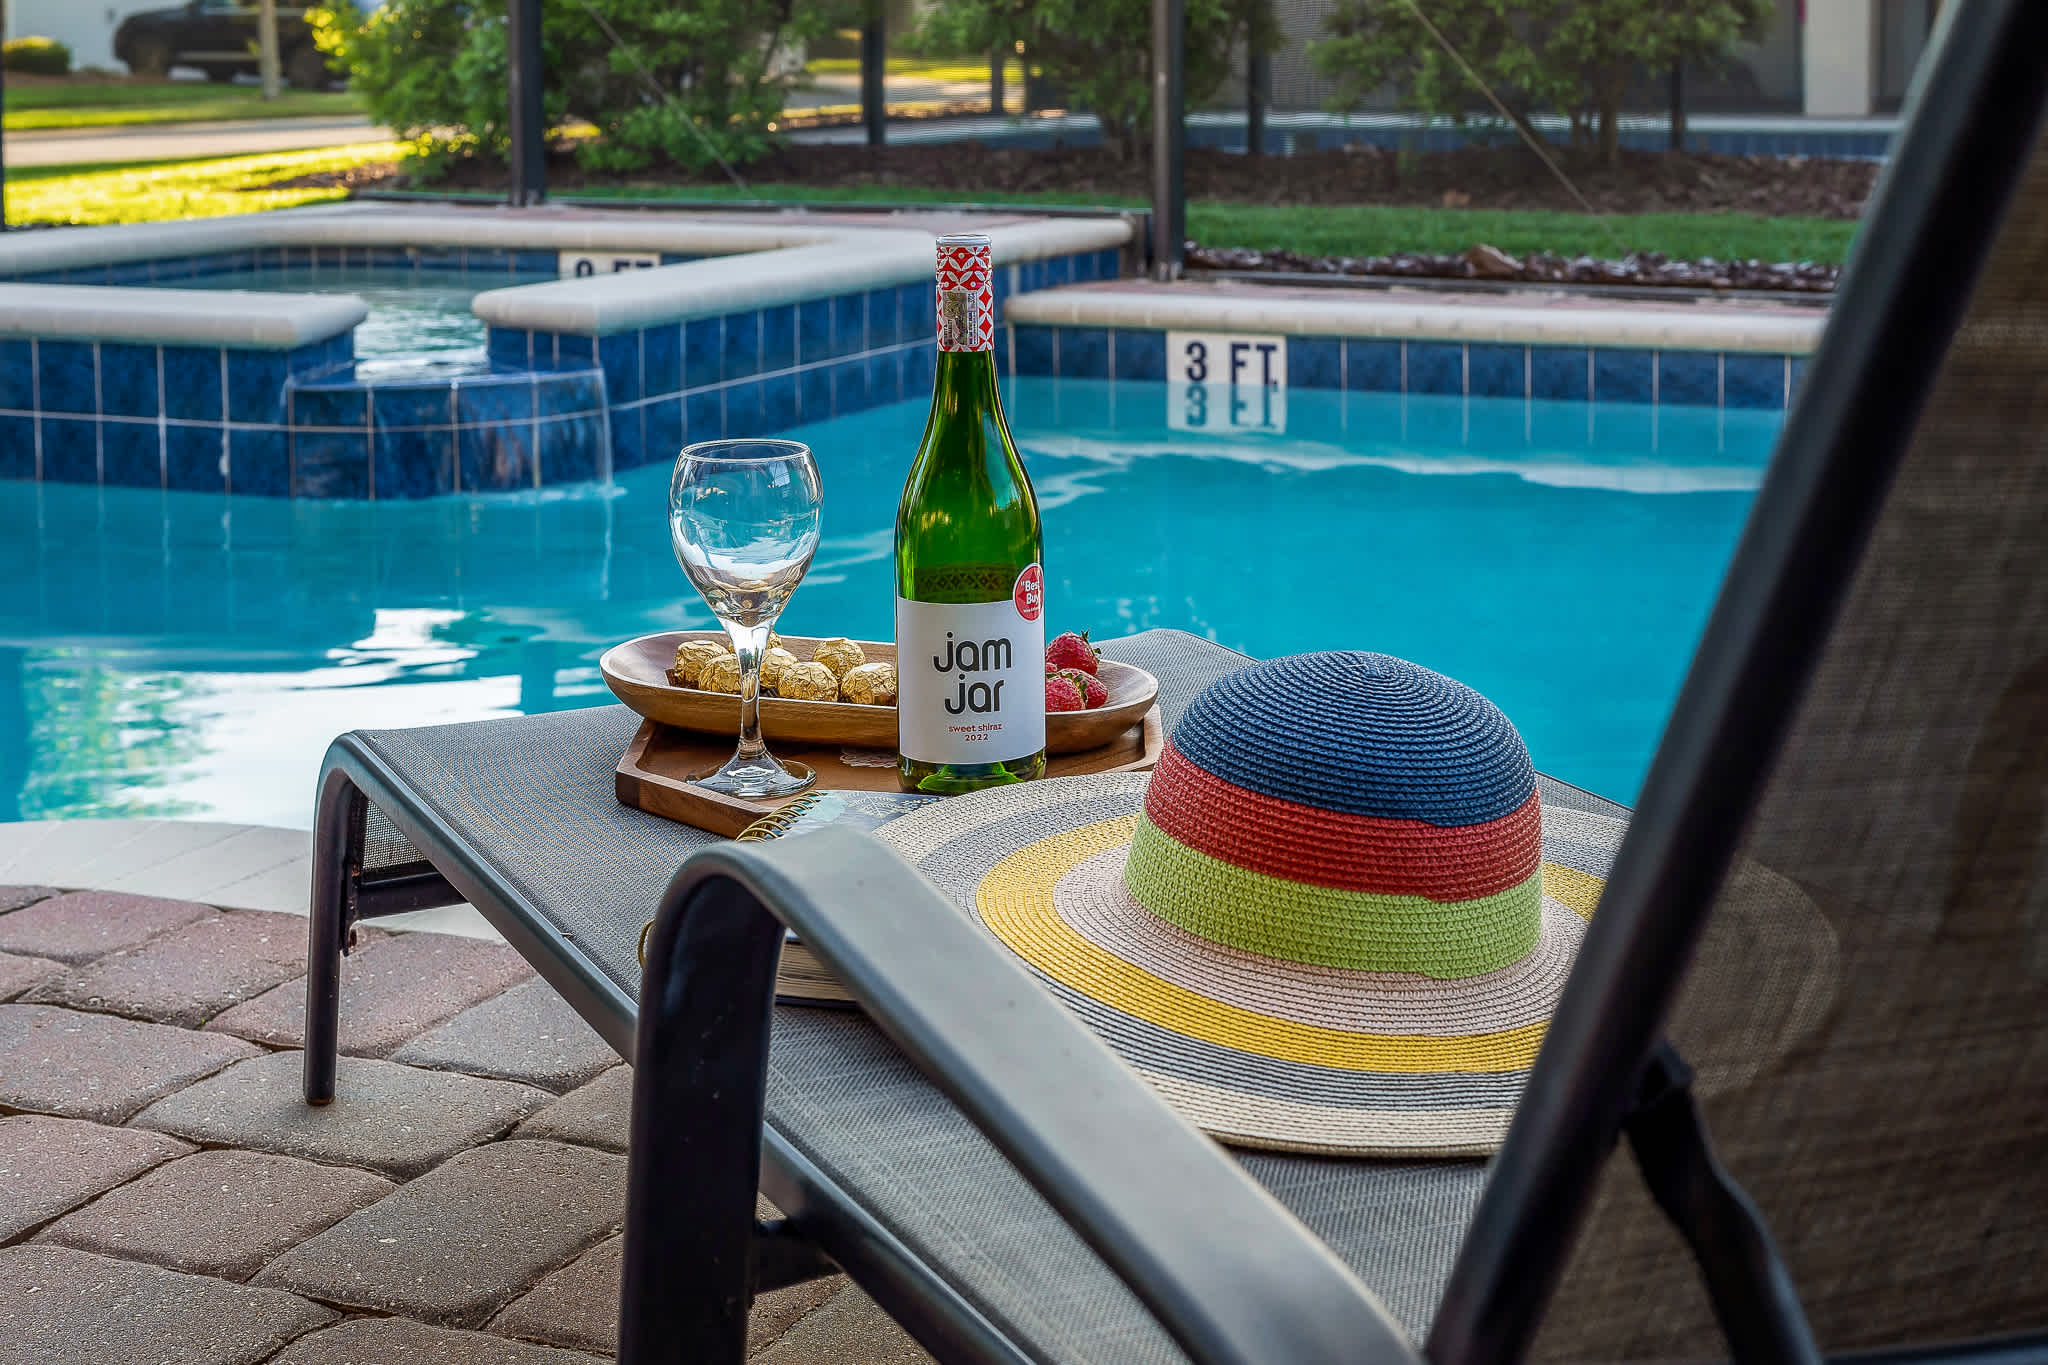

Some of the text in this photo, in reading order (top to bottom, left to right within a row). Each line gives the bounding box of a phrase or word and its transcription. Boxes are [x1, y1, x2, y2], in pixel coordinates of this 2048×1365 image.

[1186, 342, 1207, 382] 3
[933, 631, 1012, 673] jam
[944, 673, 1005, 715] jar
[948, 723, 1003, 733] sweet shiraz
[965, 733, 989, 742] 2022
